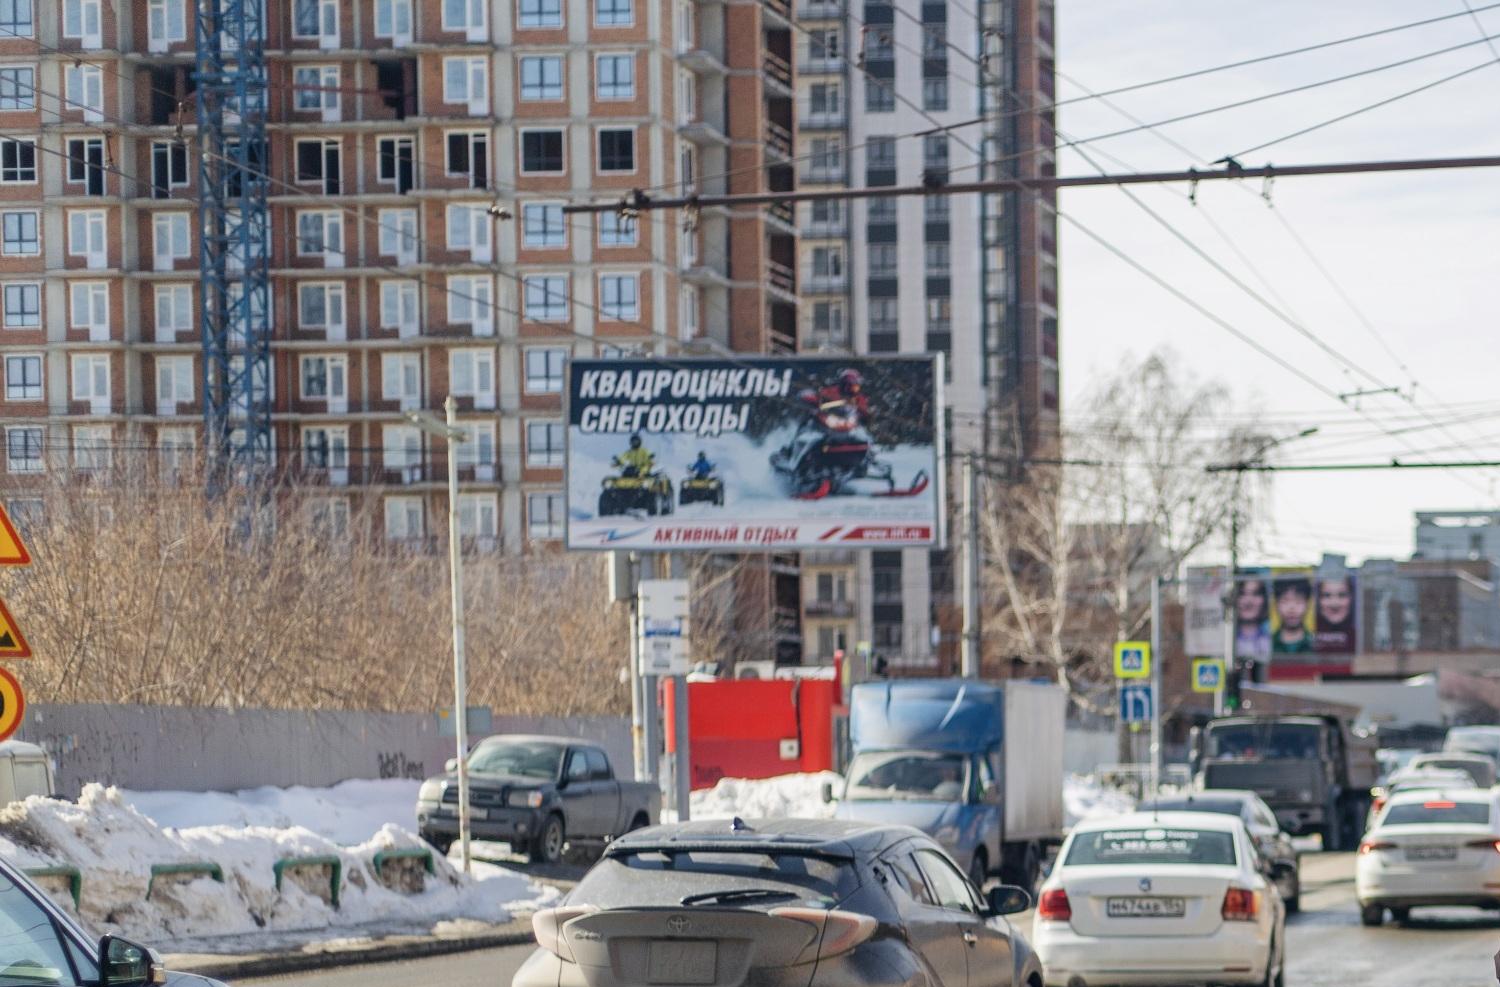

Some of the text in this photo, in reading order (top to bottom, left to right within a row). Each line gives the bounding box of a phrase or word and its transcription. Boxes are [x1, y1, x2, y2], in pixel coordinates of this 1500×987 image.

[580, 370, 790, 402] КВАДРОЦИКЛЫ
[580, 404, 749, 436] СНЕГОХОДЫ
[654, 526, 797, 544] АКТИВНЫЙ ОТДЫХ
